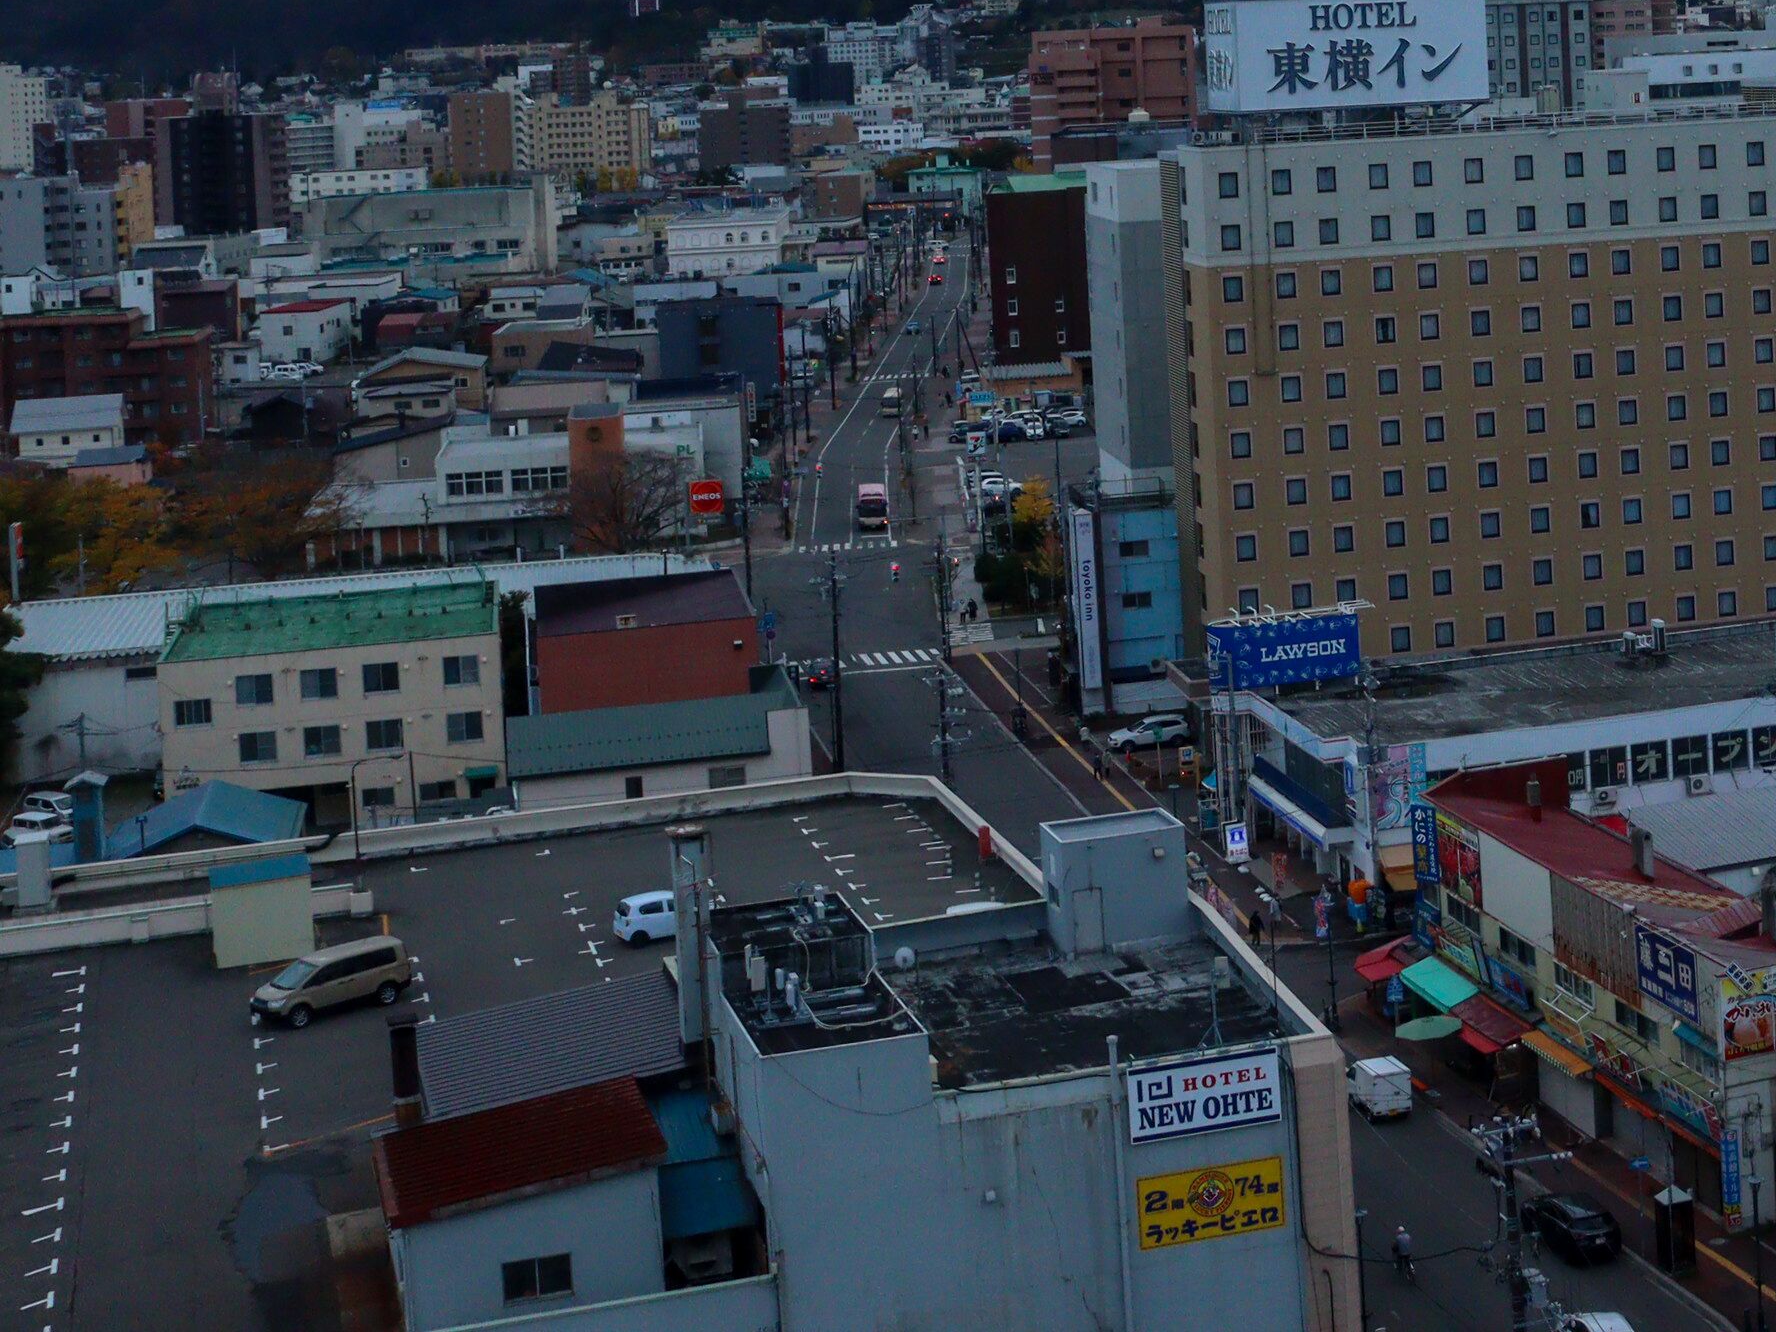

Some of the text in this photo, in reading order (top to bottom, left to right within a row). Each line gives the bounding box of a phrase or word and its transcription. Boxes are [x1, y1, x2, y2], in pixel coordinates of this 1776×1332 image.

[1309, 1, 1417, 31] HOTEL
[1266, 38, 1463, 94] 東横イン
[676, 444, 696, 456] PL
[692, 492, 721, 501] ENEOS
[1082, 560, 1093, 621] toyoko inn
[1260, 639, 1346, 663] LAWSON
[1183, 1067, 1266, 1092] HOTEL
[1139, 1087, 1273, 1130] NEW OHTE
[1146, 1206, 1279, 1244] ラッキーピエロ
